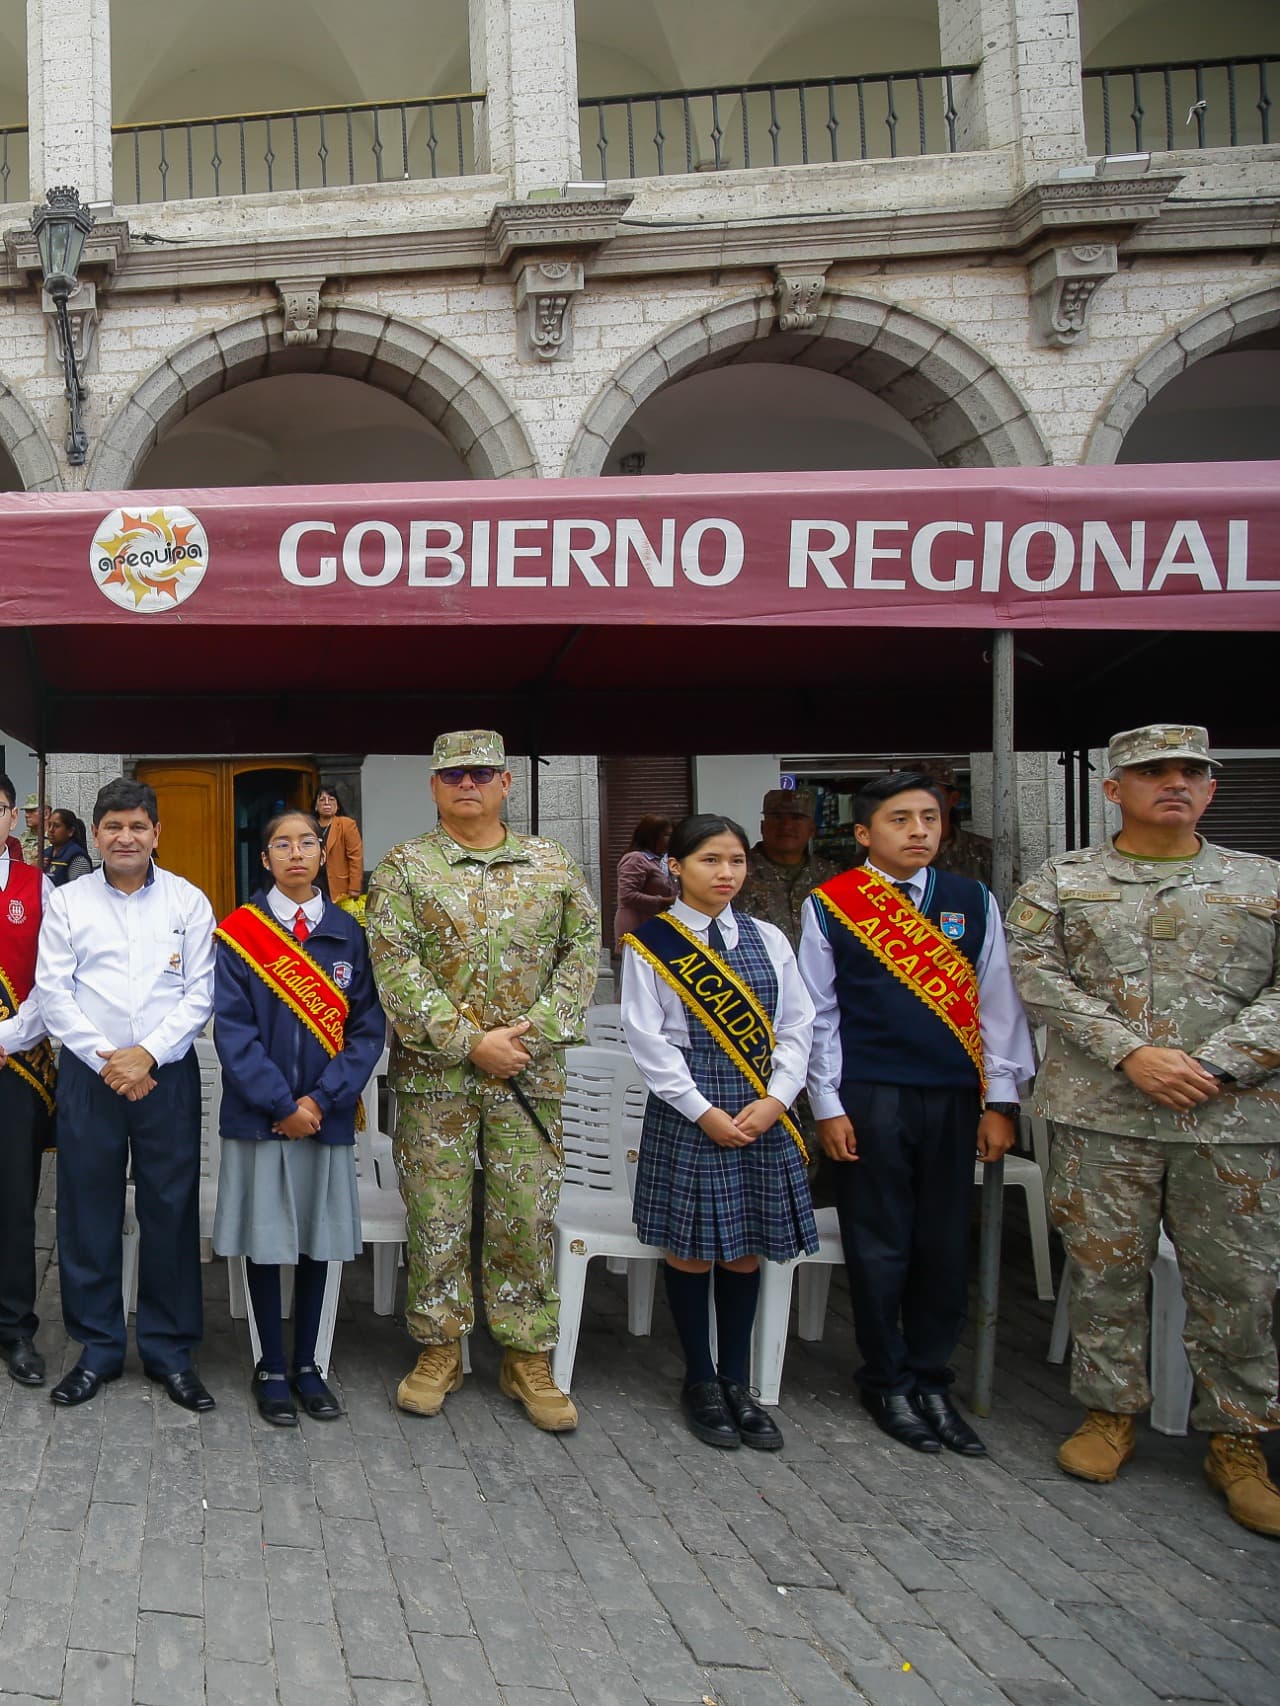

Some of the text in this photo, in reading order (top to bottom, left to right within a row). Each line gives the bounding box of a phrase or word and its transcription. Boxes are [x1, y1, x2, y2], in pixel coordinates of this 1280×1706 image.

[278, 516, 1280, 593] GOBIERNO REGIONAL
[856, 916, 960, 1012] ALCALDE
[857, 878, 892, 912] I.E.
[888, 908, 930, 945] SAN
[924, 945, 969, 988] JUAN
[264, 955, 326, 1015] Alcaldesa
[670, 952, 766, 1053] ALCALDE
